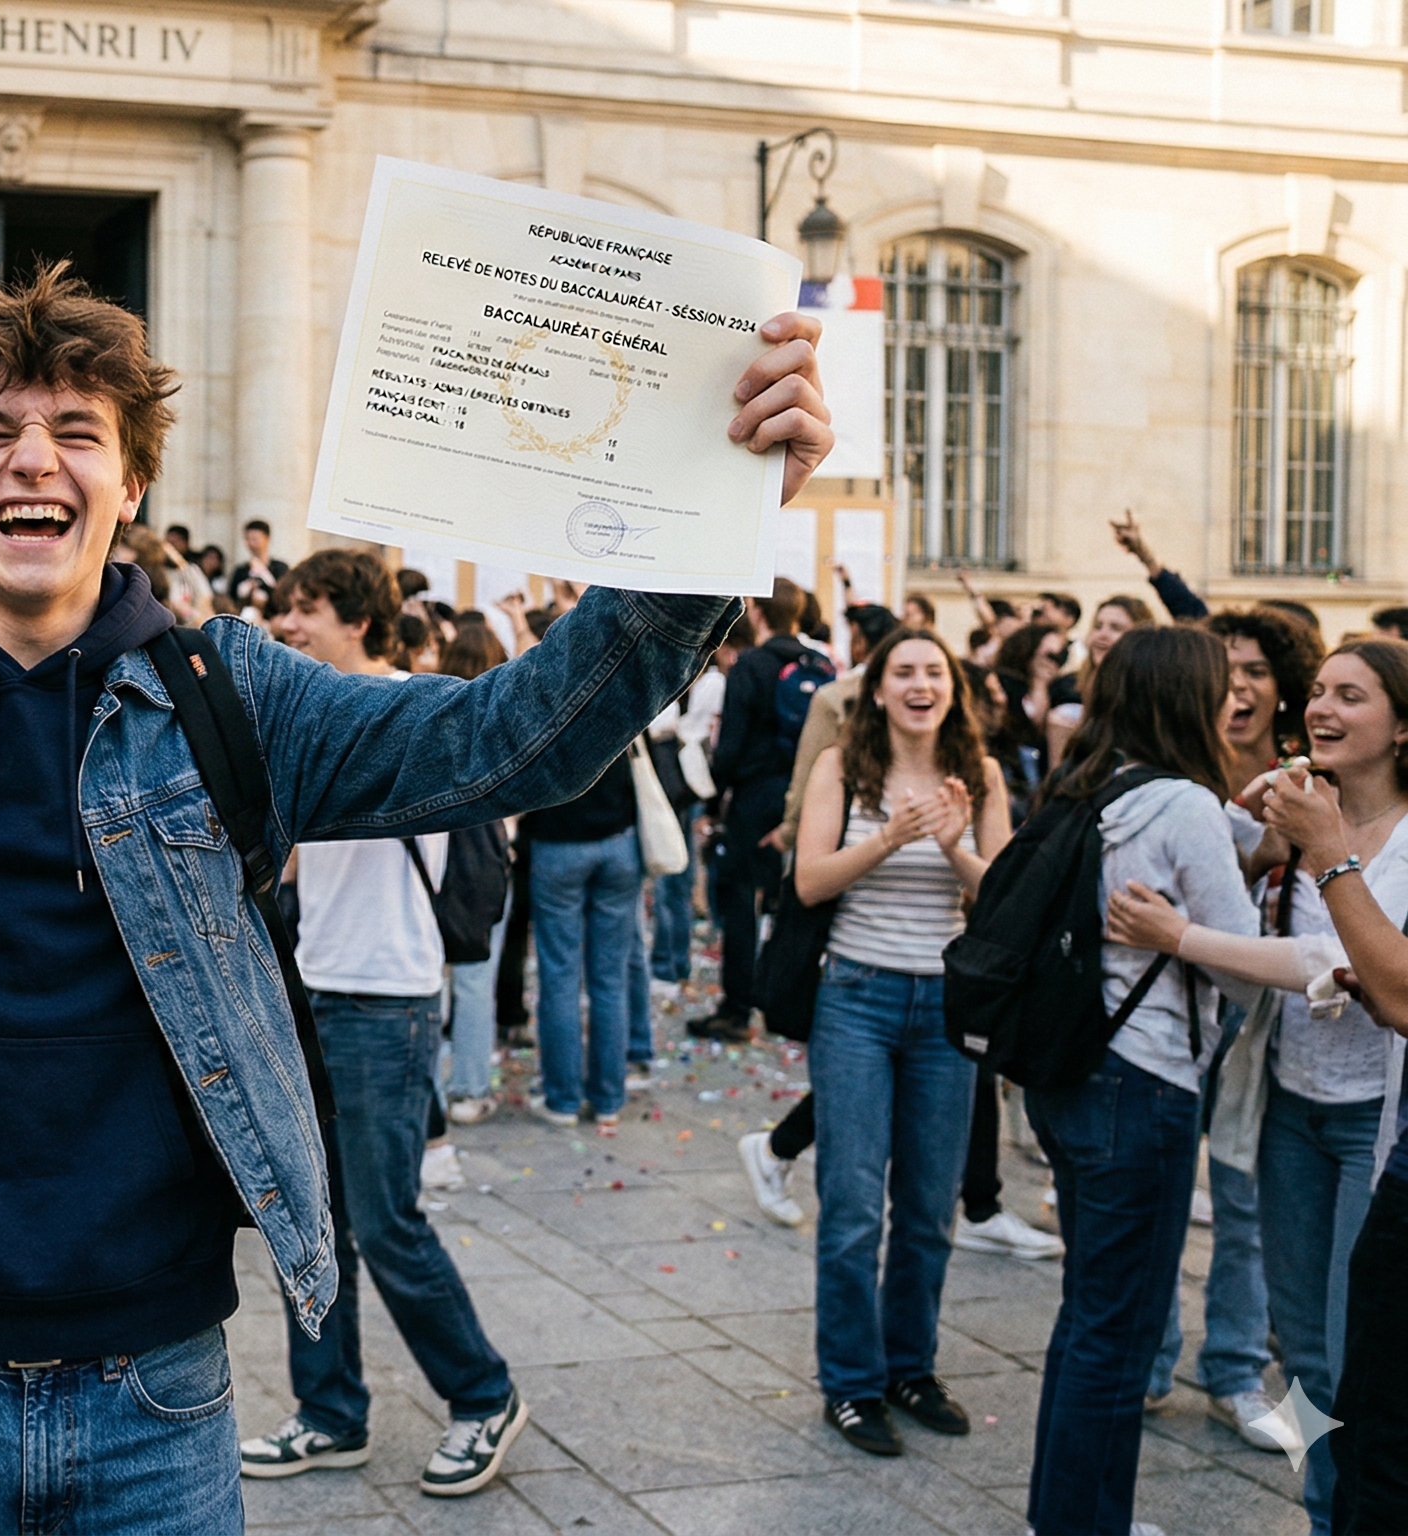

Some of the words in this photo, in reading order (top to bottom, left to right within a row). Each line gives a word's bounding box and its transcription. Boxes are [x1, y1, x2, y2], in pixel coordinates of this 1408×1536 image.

[0, 16, 136, 59] HENRI
[161, 27, 203, 61] IV
[528, 224, 603, 251] RÉPUBLIQUE
[605, 241, 673, 265] FRANÇAISE
[421, 251, 472, 272] RELEVÉ
[474, 262, 493, 277] DE
[494, 266, 538, 286] NOTES
[539, 276, 559, 291] DU
[560, 280, 663, 313] BACCALAURÉAT
[483, 304, 600, 340] BACCALAURÉAT
[602, 330, 668, 356] GÉNÉRAL
